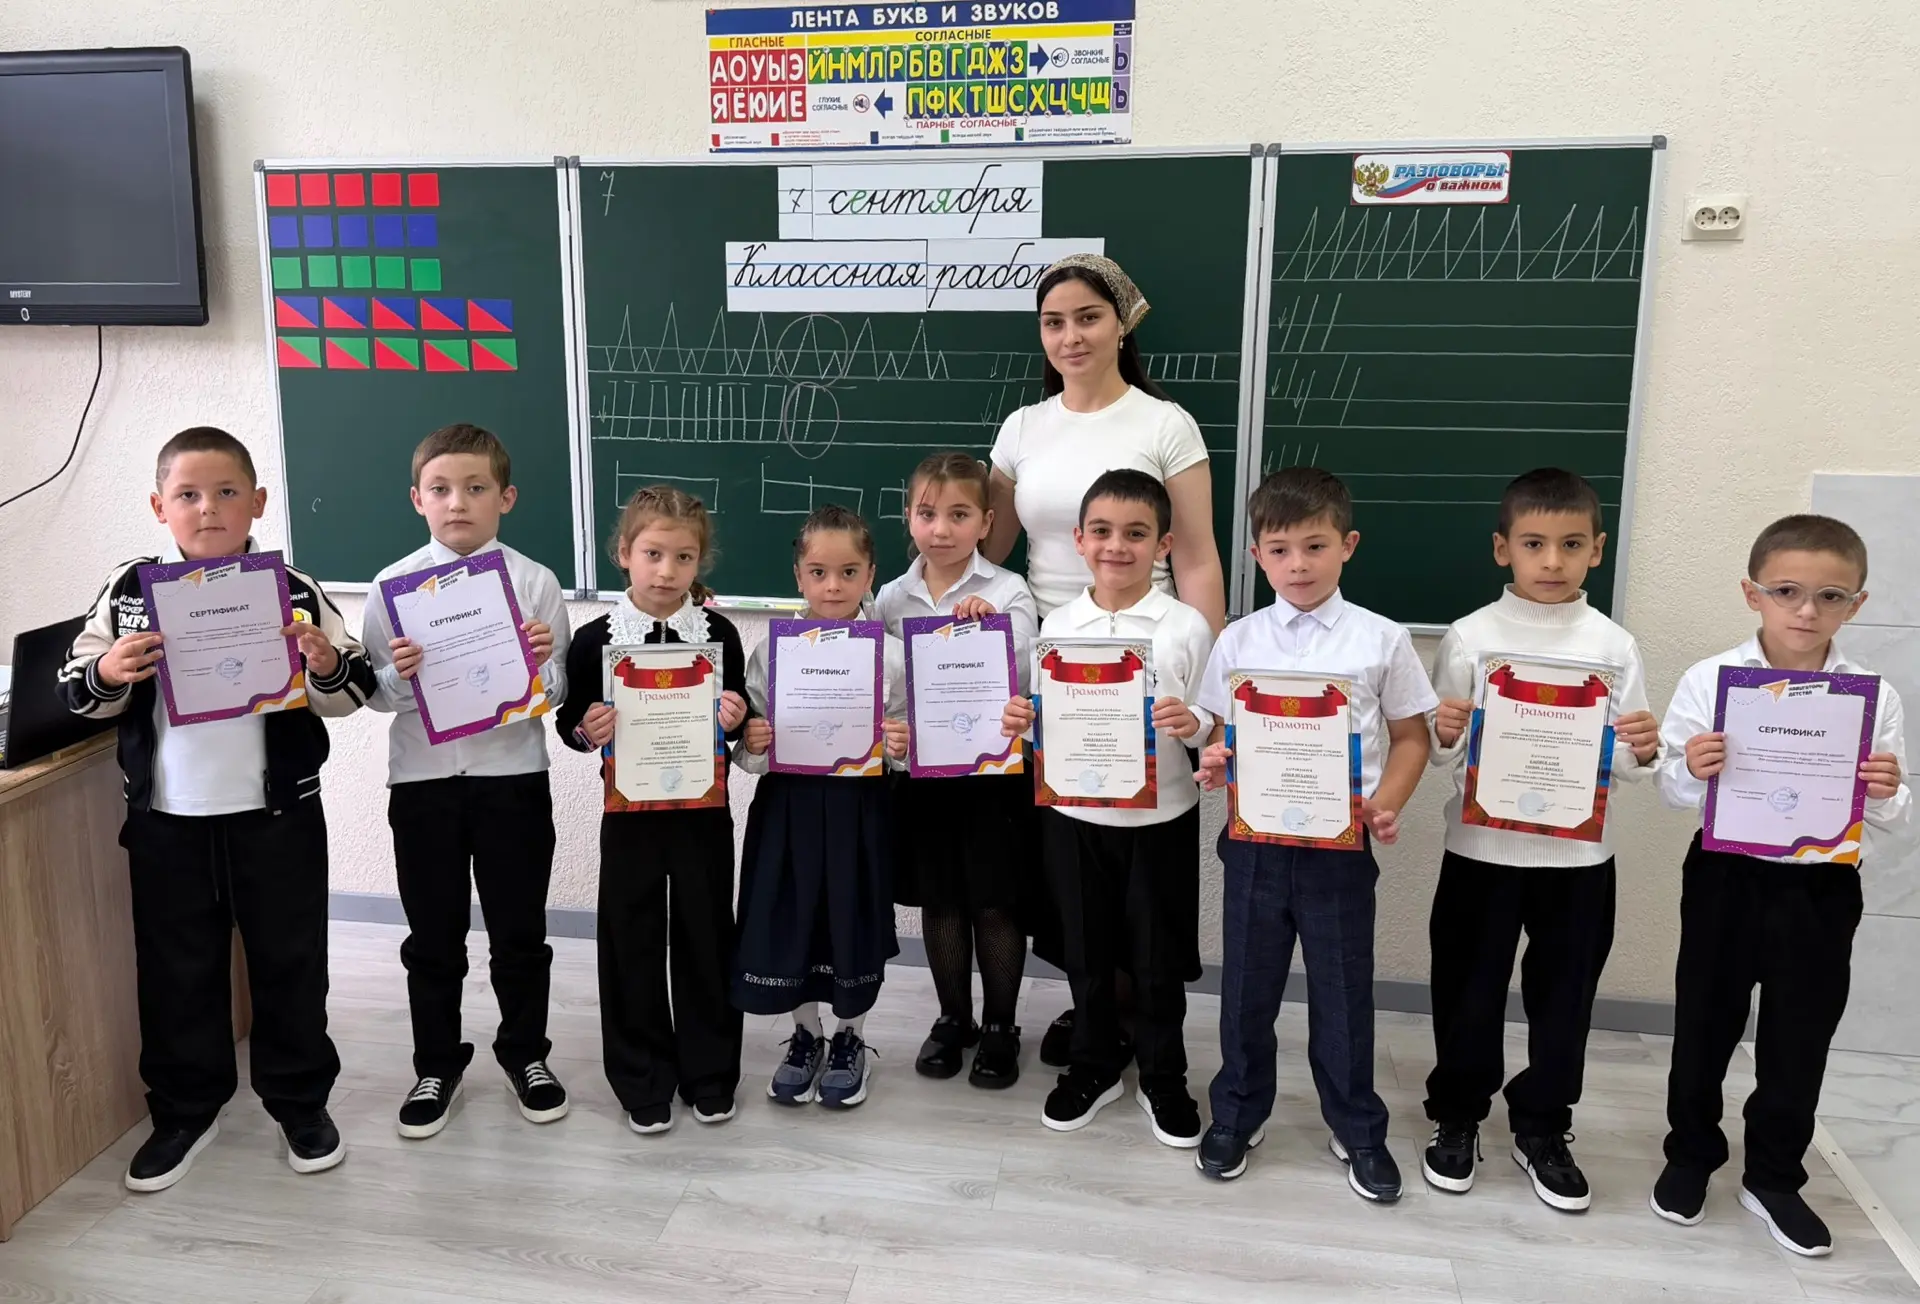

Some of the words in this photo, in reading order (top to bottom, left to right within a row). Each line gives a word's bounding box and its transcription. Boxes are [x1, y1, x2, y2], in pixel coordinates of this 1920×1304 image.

[790, 8, 860, 28] ЛЕНТА
[872, 6, 928, 26] БУКВ
[942, 5, 956, 23] И
[971, 2, 1059, 21] ЗВУКОВ
[915, 29, 991, 41] СОГЛАСНЫЕ
[729, 36, 785, 48] ГЛАСНЫЕ
[1074, 49, 1104, 57] ЗВОНКИЕ
[1071, 57, 1110, 65] СОГЛАСНЫЕ
[916, 120, 955, 129] ПАРНЫЕ
[960, 119, 1017, 128] СОГЛАСНЫЕ
[1394, 163, 1507, 178] РАЗГОВОРЫ
[1426, 182, 1436, 191] о
[1440, 180, 1502, 192] важном
[788, 188, 807, 213] 7
[828, 164, 1033, 234] сентября
[733, 243, 927, 289] Классная
[928, 242, 1051, 308] рабо
[189, 603, 250, 618] СЕРТИФИКАТ
[429, 608, 483, 628] СЕРТИФИКАТ
[801, 668, 850, 676] СЕРТИФИКАТ
[937, 662, 985, 670] СЕРТИФИКАТ
[638, 691, 690, 704] Грамота
[1066, 685, 1119, 699] Грамота
[1514, 703, 1576, 720] Грамота
[1262, 717, 1321, 731] Грамота
[1758, 725, 1827, 738] СЕРТИФИКАТ
